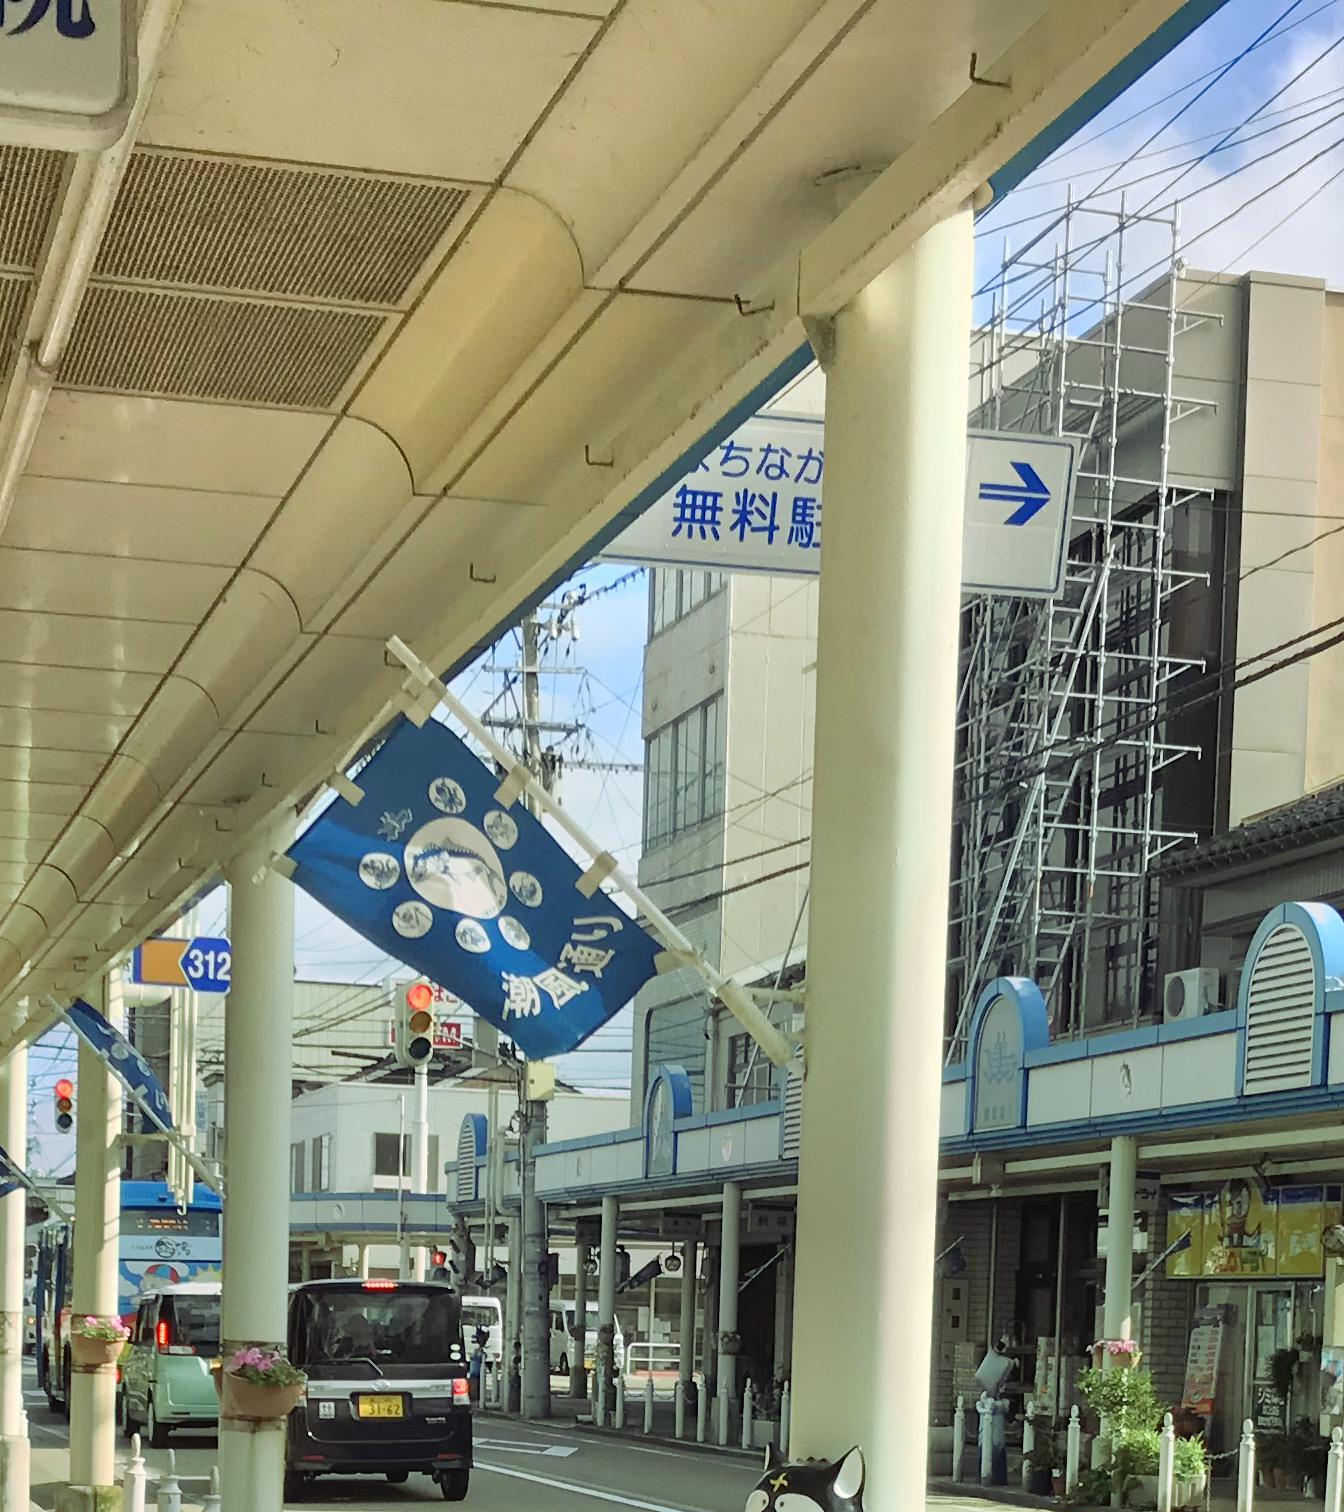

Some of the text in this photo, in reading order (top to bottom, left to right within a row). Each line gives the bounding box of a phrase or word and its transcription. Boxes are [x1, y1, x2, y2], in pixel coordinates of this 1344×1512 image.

[689, 440, 824, 484] ちなか
[188, 950, 231, 980] 312
